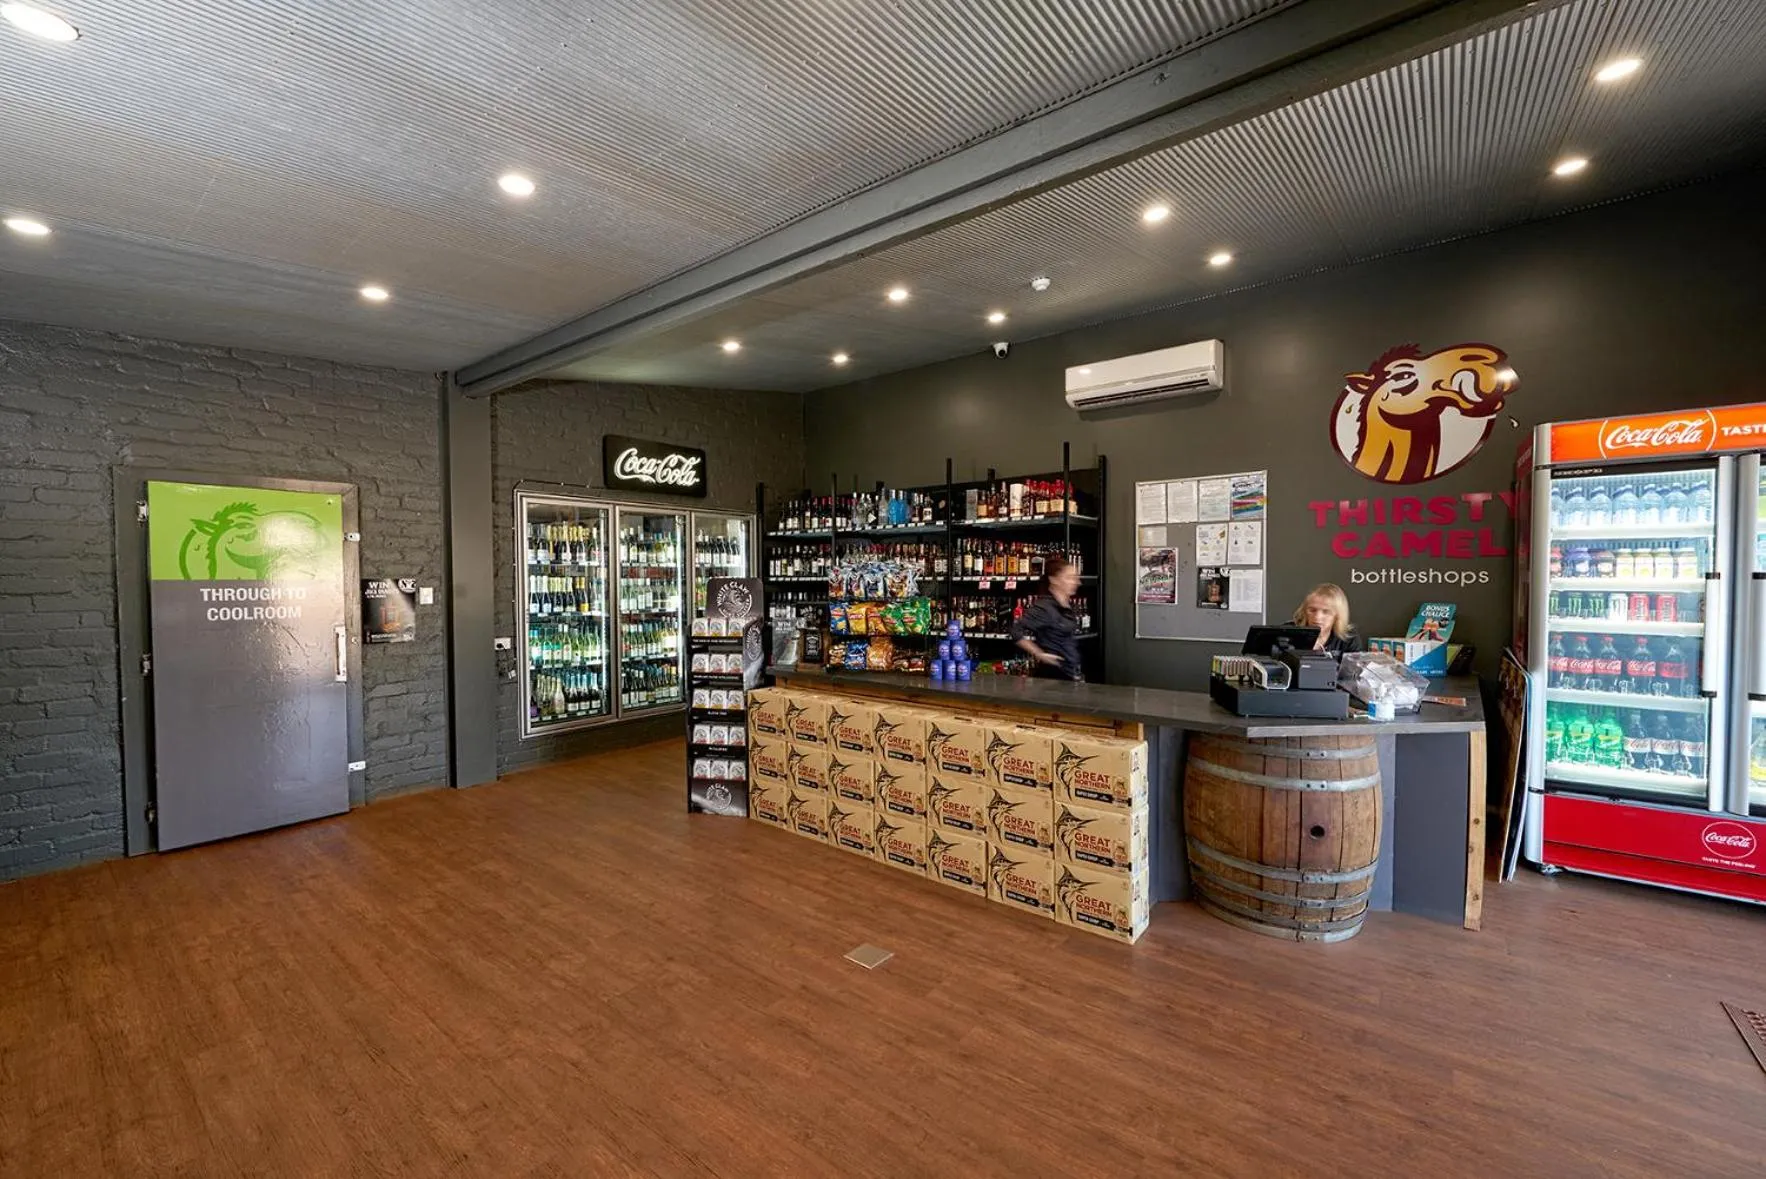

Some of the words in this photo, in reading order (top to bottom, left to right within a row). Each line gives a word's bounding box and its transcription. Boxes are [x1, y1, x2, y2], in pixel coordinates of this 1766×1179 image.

[1605, 419, 1710, 450] Coca-Cola
[614, 448, 701, 487] Coca-Cola
[1331, 528, 1508, 559] CAMEL
[1351, 568, 1489, 587] bottleshops
[200, 588, 281, 602] THROUGH
[207, 606, 302, 621] COOLROOM
[942, 746, 968, 756] GREAT
[1004, 757, 1034, 770] GREAT
[1074, 770, 1110, 784] GREAT
[1075, 779, 1110, 790] NORTHERN
[942, 801, 970, 812] GREAT
[1004, 816, 1034, 829] GREAT
[1075, 832, 1110, 847] GREAT
[1705, 832, 1752, 848] Coca-Cola
[1076, 841, 1110, 854] NORTHERN
[942, 855, 968, 866] GREAT
[1006, 872, 1036, 887] GREAT
[1076, 894, 1112, 911] GREAT
[1076, 903, 1112, 916] NORTHERN
